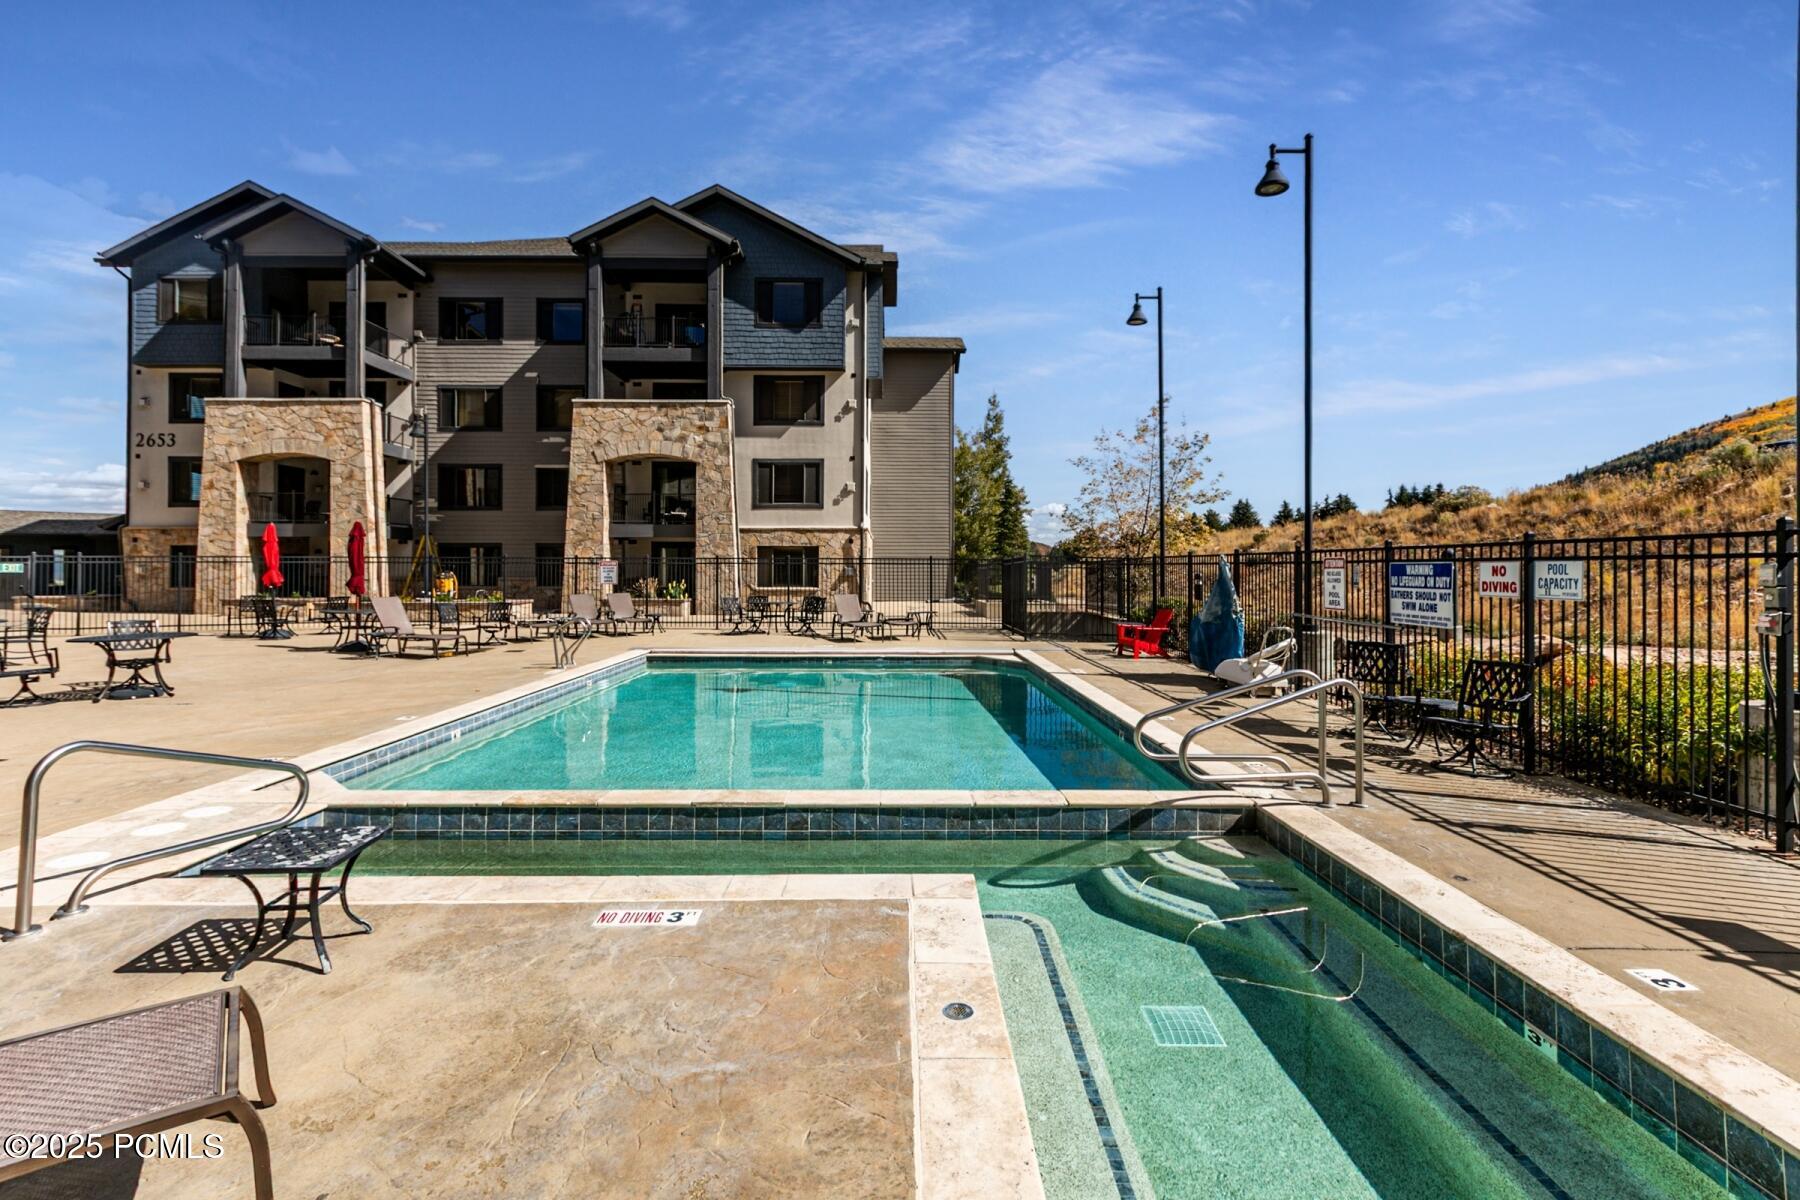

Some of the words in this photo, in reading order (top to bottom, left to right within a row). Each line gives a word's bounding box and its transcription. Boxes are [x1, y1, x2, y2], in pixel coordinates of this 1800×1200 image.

[135, 432, 176, 447] 2653
[1406, 564, 1434, 575] WARNING
[1491, 565, 1507, 576] NO
[1547, 563, 1569, 575] POOL
[1391, 576, 1398, 586] NO
[1399, 576, 1426, 587] LIFEGUARD
[1426, 576, 1435, 588] ON
[1435, 577, 1450, 588] DUTY
[1481, 581, 1517, 593] DIVING
[1537, 577, 1579, 590] CAPACITY
[1391, 590, 1413, 600] BATHERS
[1415, 591, 1438, 601] SHOULD
[1439, 592, 1452, 602] NOT
[1328, 599, 1341, 607] AREA
[1401, 601, 1417, 611] SWIM
[1418, 602, 1438, 613] ALONE
[597, 912, 618, 923] NO
[620, 911, 664, 923] DIVING
[666, 911, 684, 923] 3
[1650, 978, 1686, 988] 3
[1527, 1028, 1542, 1047] 3
